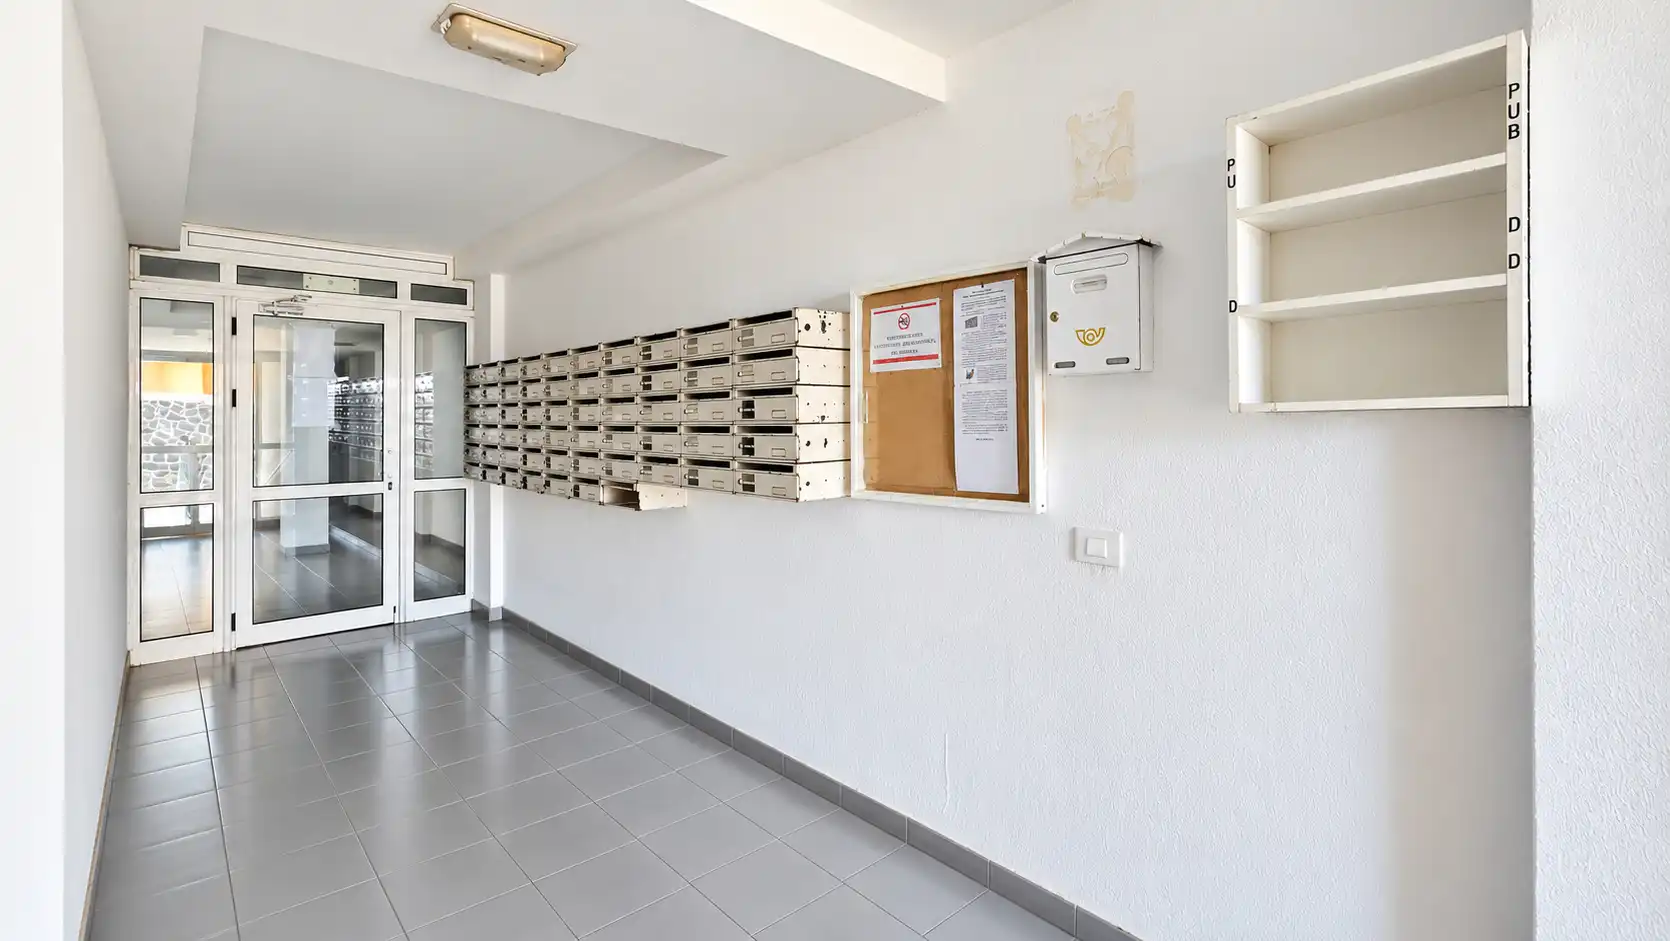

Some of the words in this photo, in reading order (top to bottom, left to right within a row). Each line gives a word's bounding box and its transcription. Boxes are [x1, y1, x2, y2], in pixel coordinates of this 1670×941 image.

[1508, 82, 1521, 140] PUB
[1227, 158, 1236, 189] PU
[1508, 217, 1521, 233] D
[1508, 253, 1521, 270] D
[1229, 300, 1237, 313] D
